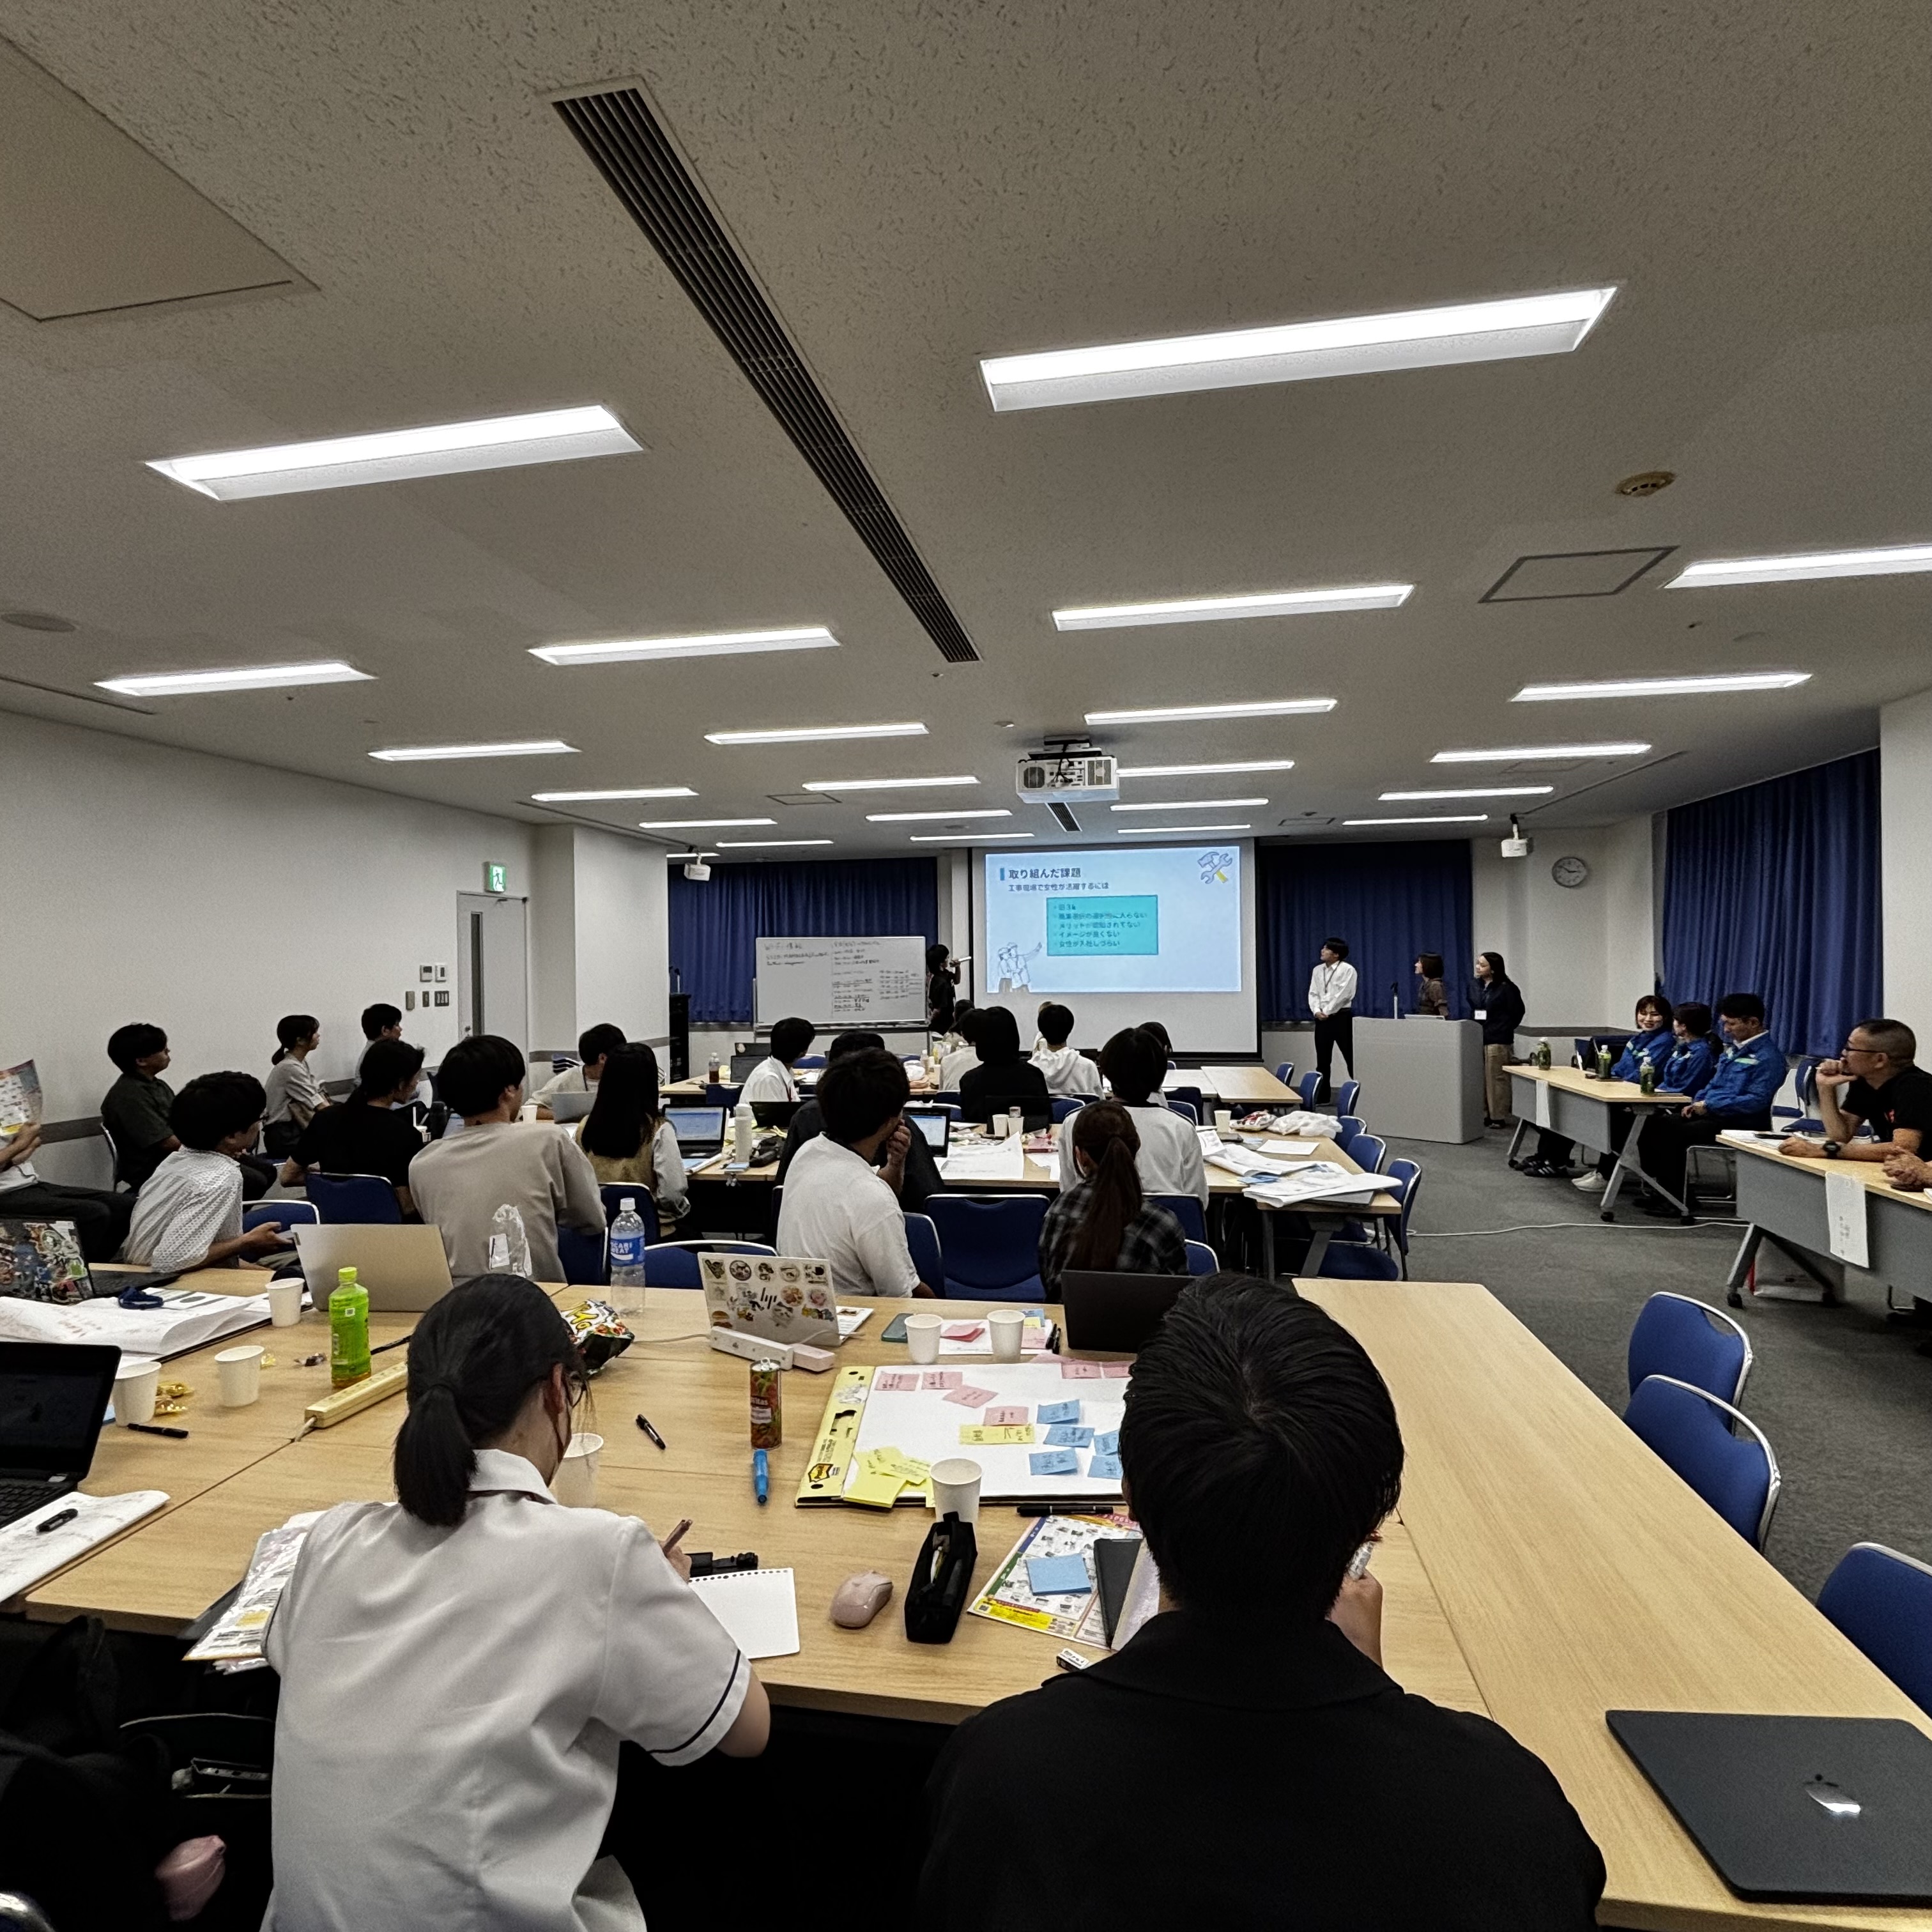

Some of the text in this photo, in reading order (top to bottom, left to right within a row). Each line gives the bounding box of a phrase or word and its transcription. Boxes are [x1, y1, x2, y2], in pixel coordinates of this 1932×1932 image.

[1008, 868, 1081, 879] 取り組んだ課題
